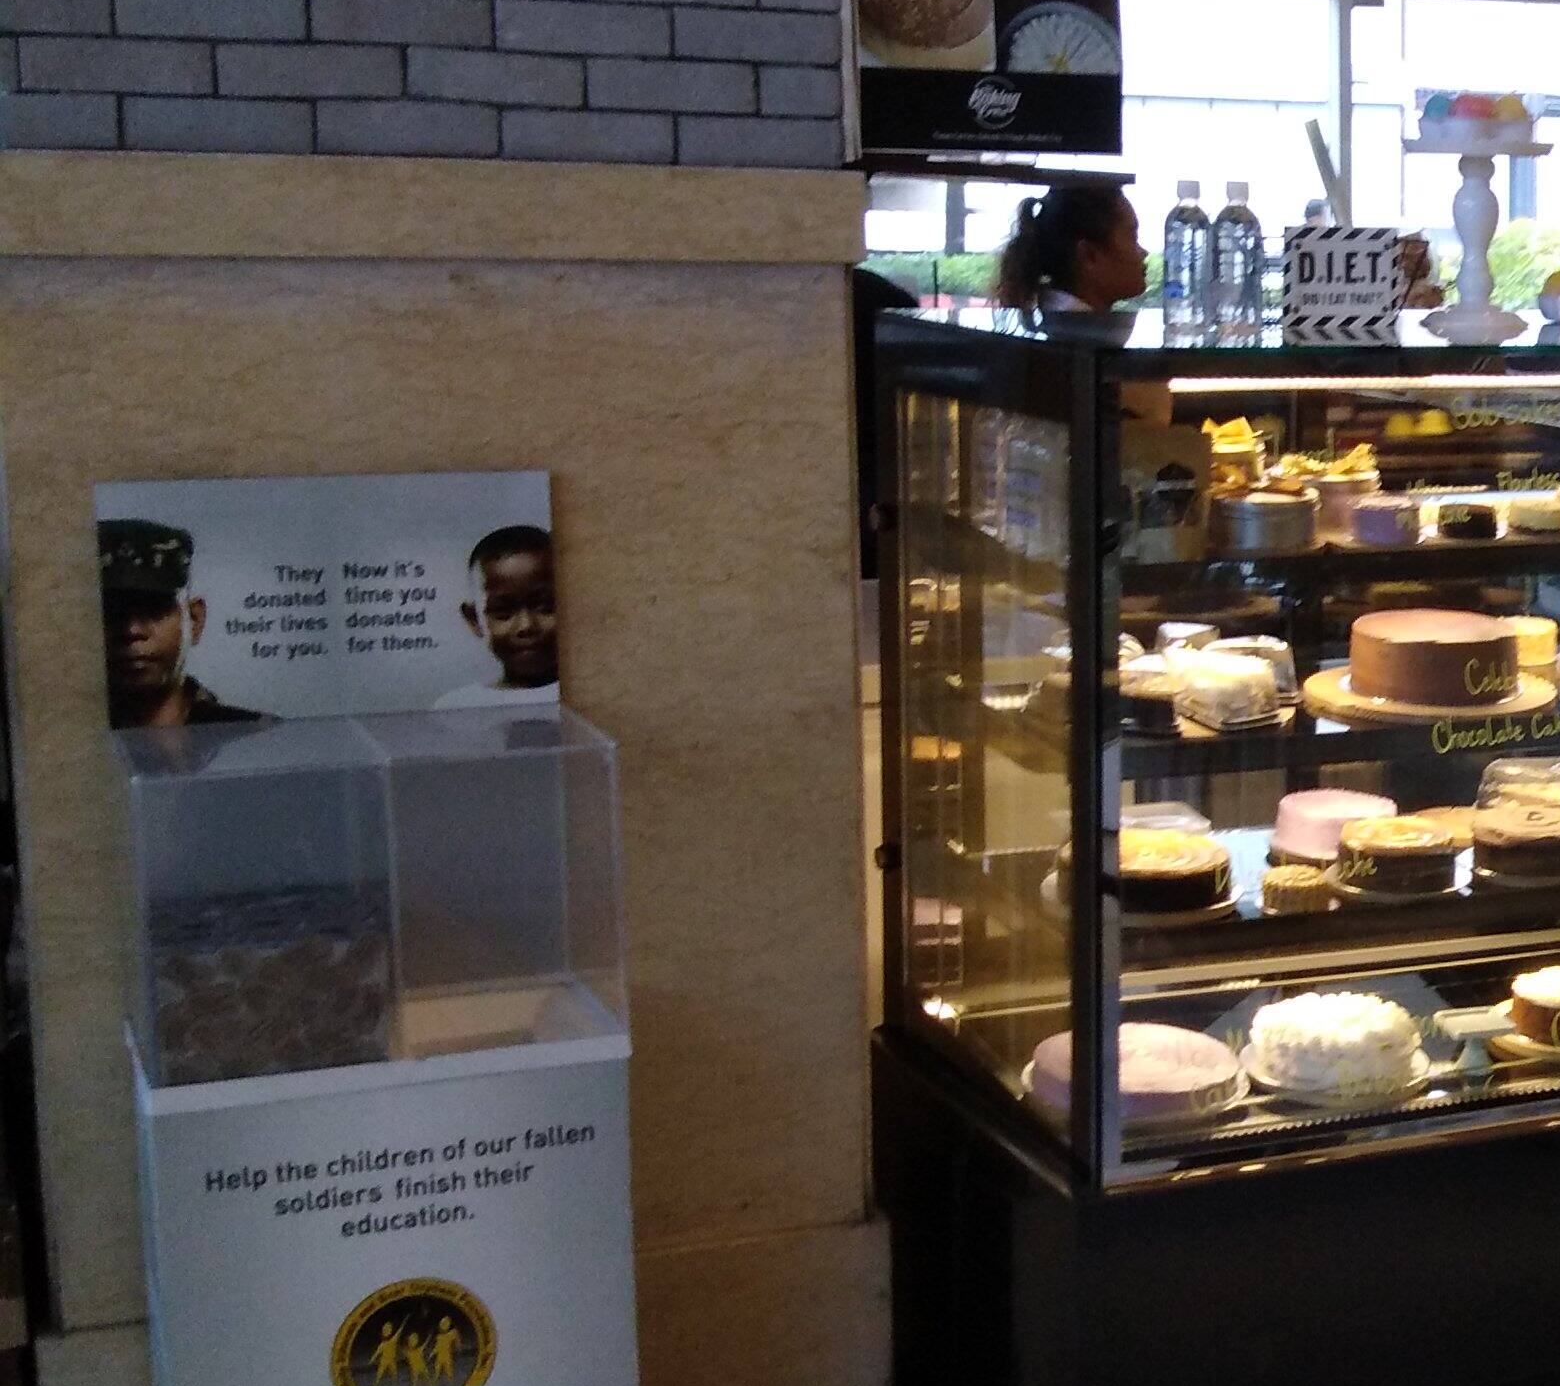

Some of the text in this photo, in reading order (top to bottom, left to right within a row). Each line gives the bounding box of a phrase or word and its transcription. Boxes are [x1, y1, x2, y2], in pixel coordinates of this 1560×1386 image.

[1297, 250, 1388, 284] D.I.E.T.
[274, 564, 324, 585] They
[342, 560, 426, 580] Now it's
[244, 588, 326, 609] donated
[345, 586, 437, 606] time you
[225, 614, 328, 636] their lives
[345, 608, 426, 629] donated
[251, 641, 328, 661] for you.
[346, 634, 440, 654] for them.
[204, 1122, 596, 1193] Help the children of our fallen
[274, 1160, 535, 1217] soldiers finish their
[339, 1202, 476, 1239] education.
